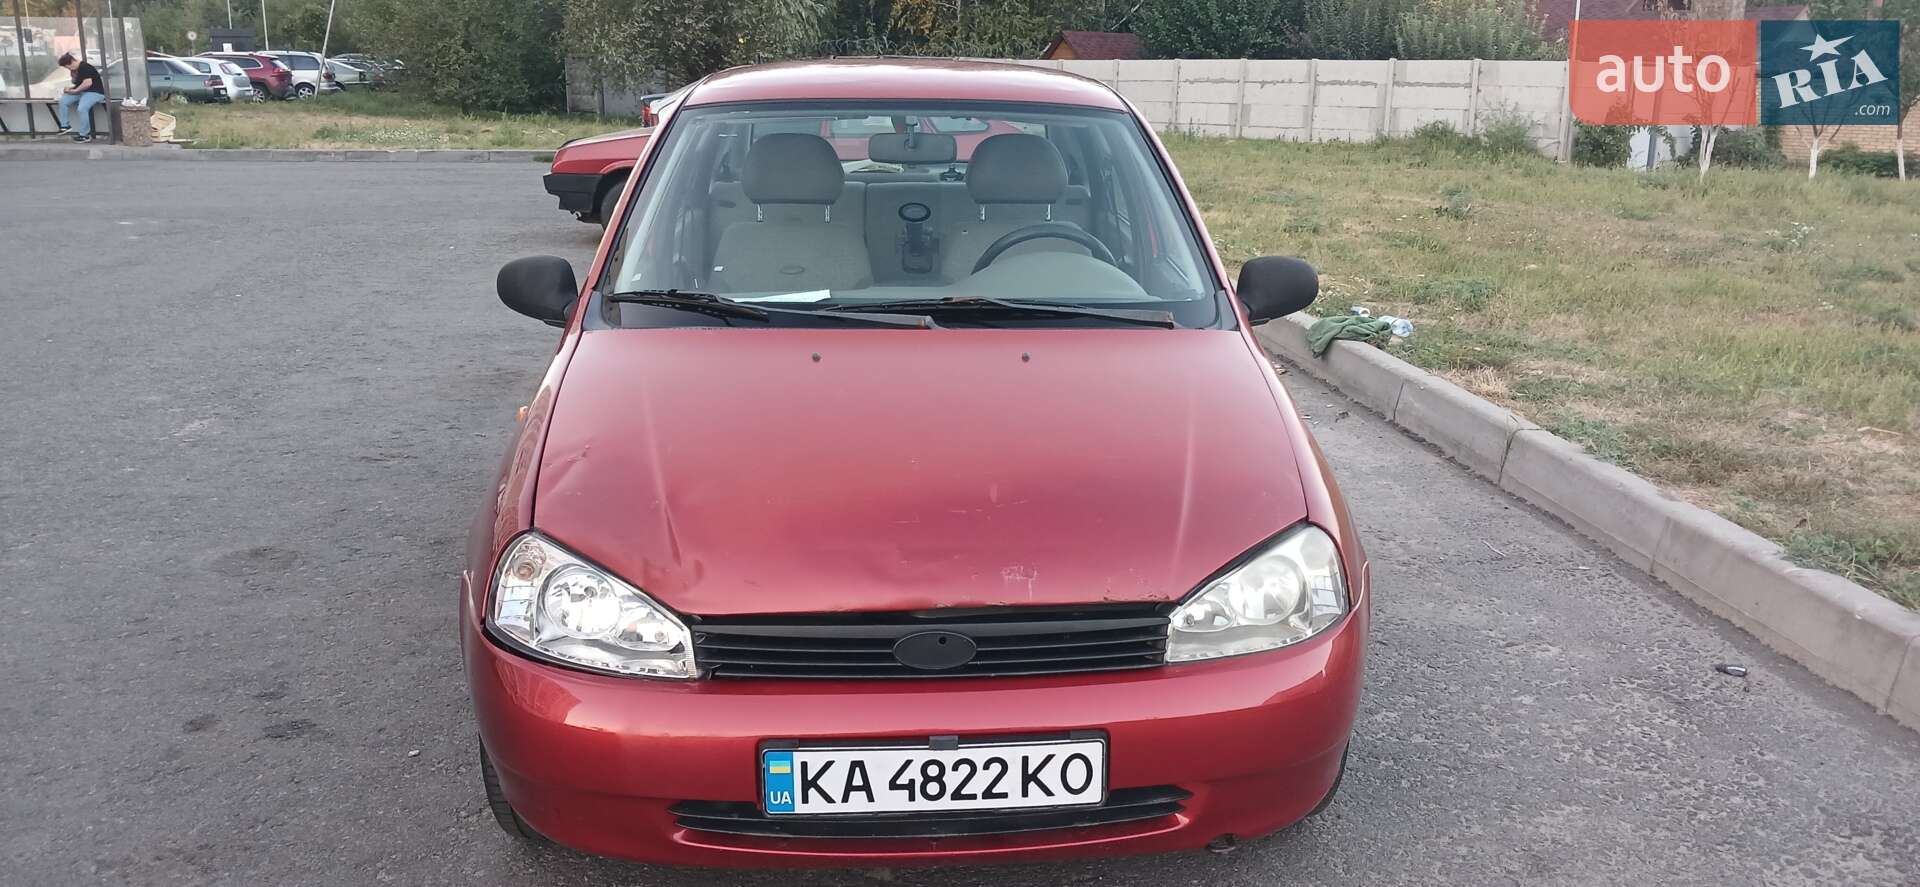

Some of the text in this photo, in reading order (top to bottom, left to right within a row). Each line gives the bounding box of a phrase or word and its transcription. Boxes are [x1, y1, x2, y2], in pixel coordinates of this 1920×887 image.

[770, 752, 1094, 805] UA KA 4822 KO
